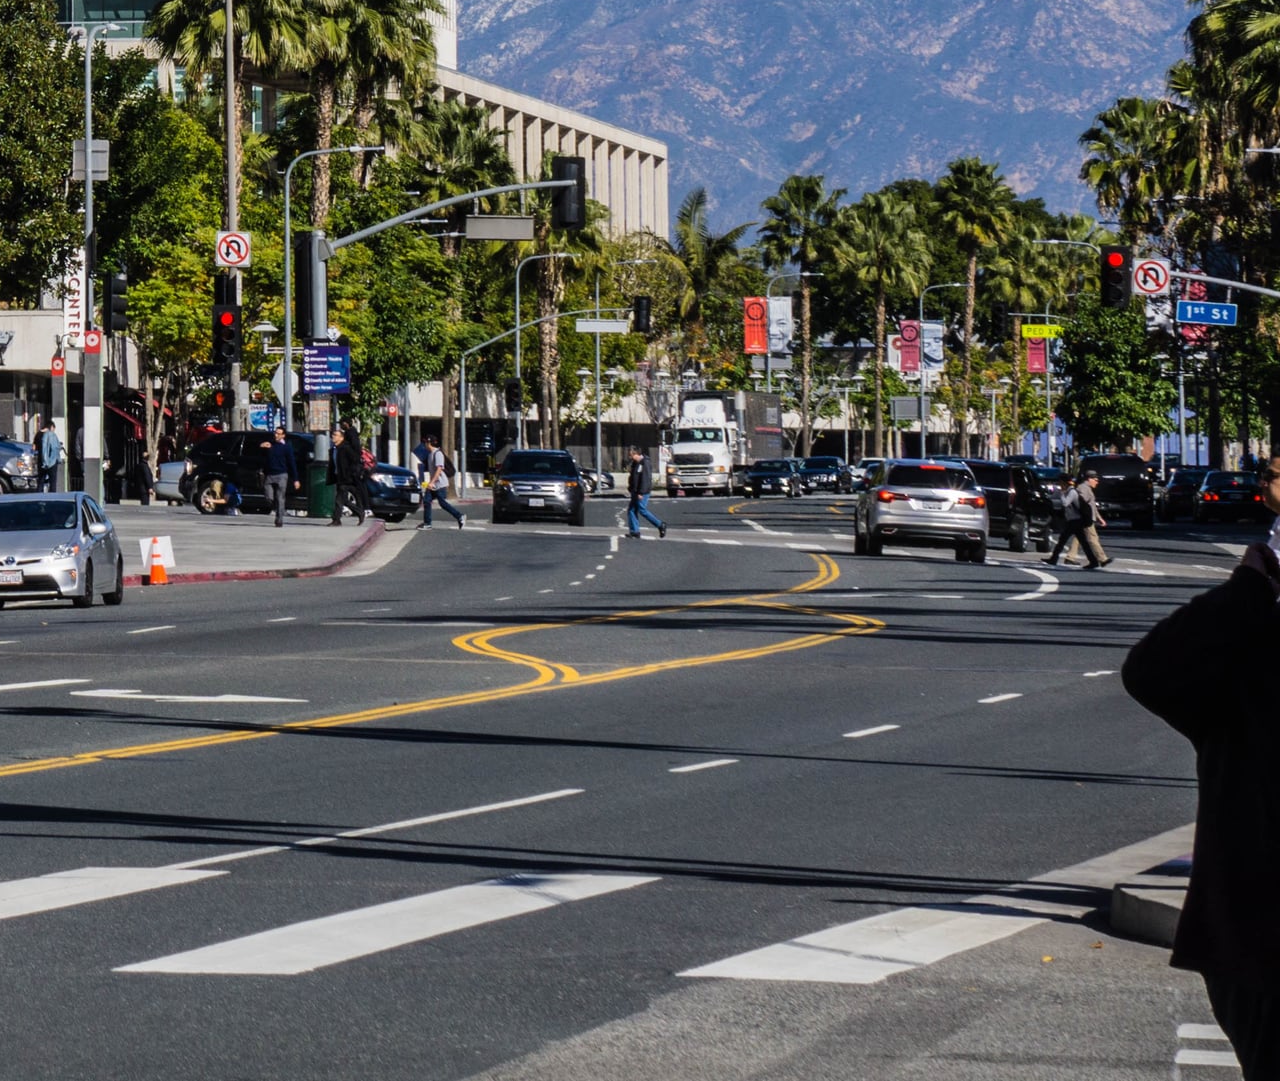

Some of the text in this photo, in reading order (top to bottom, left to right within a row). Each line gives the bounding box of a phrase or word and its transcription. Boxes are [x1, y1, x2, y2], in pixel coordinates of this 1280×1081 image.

[1186, 305, 1229, 320] 1st St
[1026, 327, 1044, 335] PED
